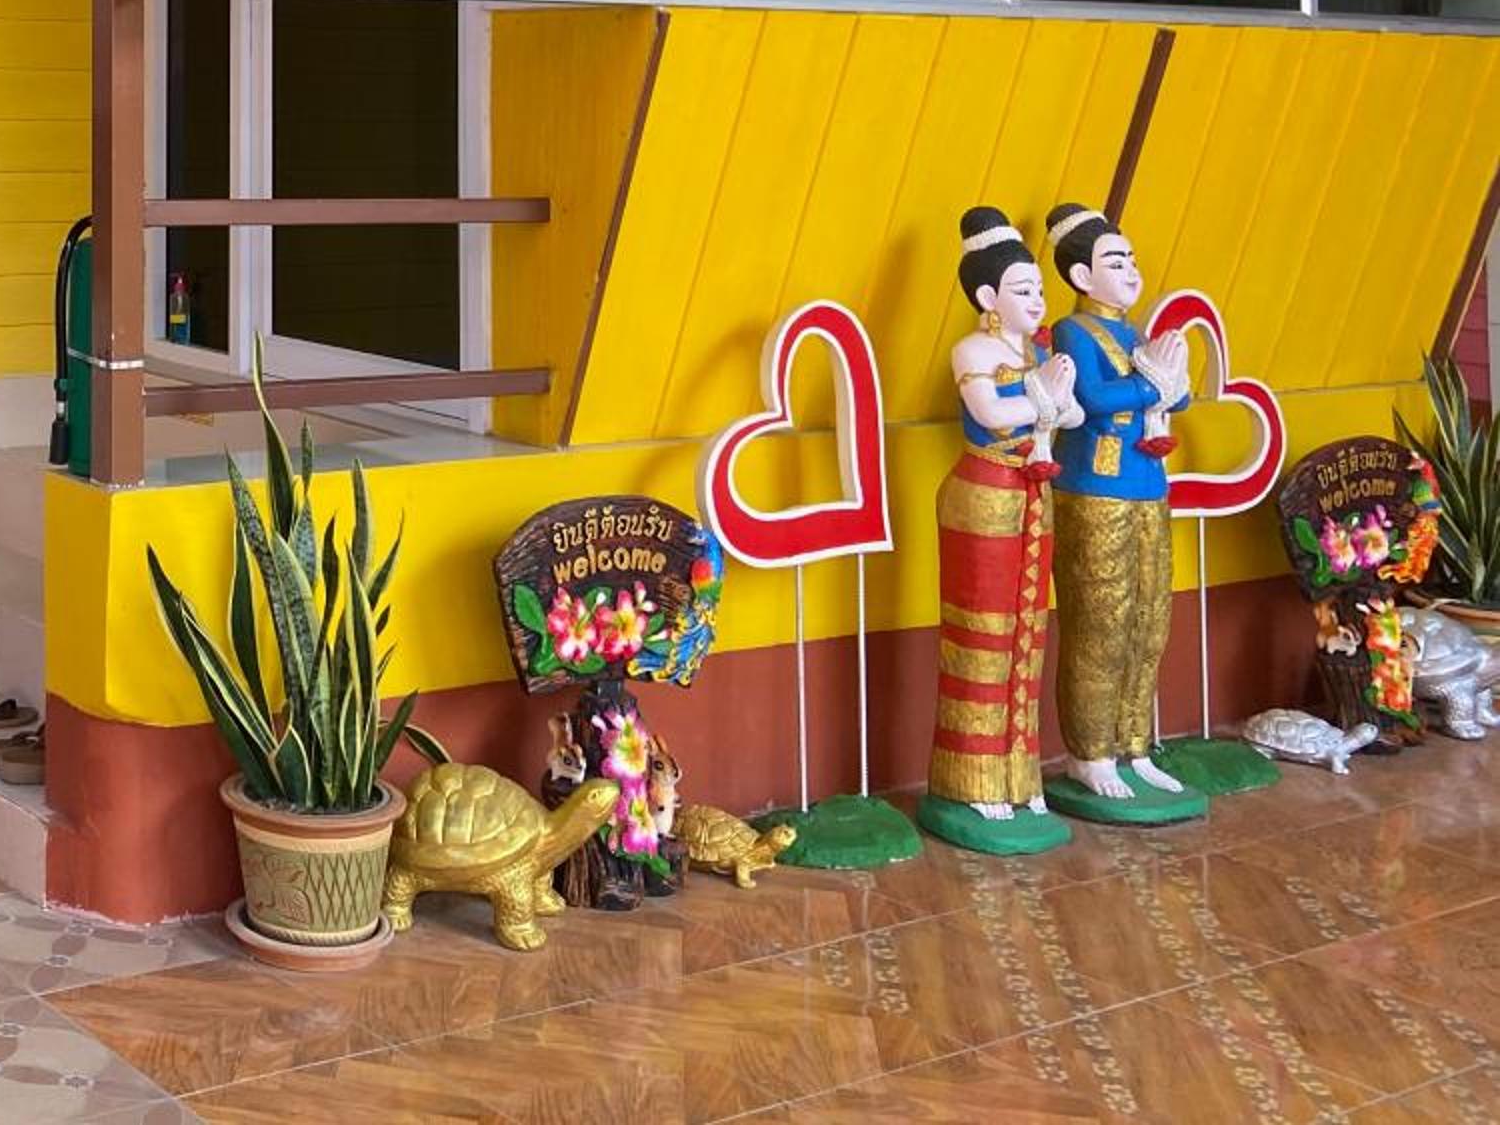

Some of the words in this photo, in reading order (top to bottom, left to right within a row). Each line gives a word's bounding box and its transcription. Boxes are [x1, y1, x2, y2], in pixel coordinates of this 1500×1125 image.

[1320, 478, 1396, 513] welcome
[553, 505, 673, 553] ยินดีต้อนรับ
[554, 544, 667, 583] welcome
